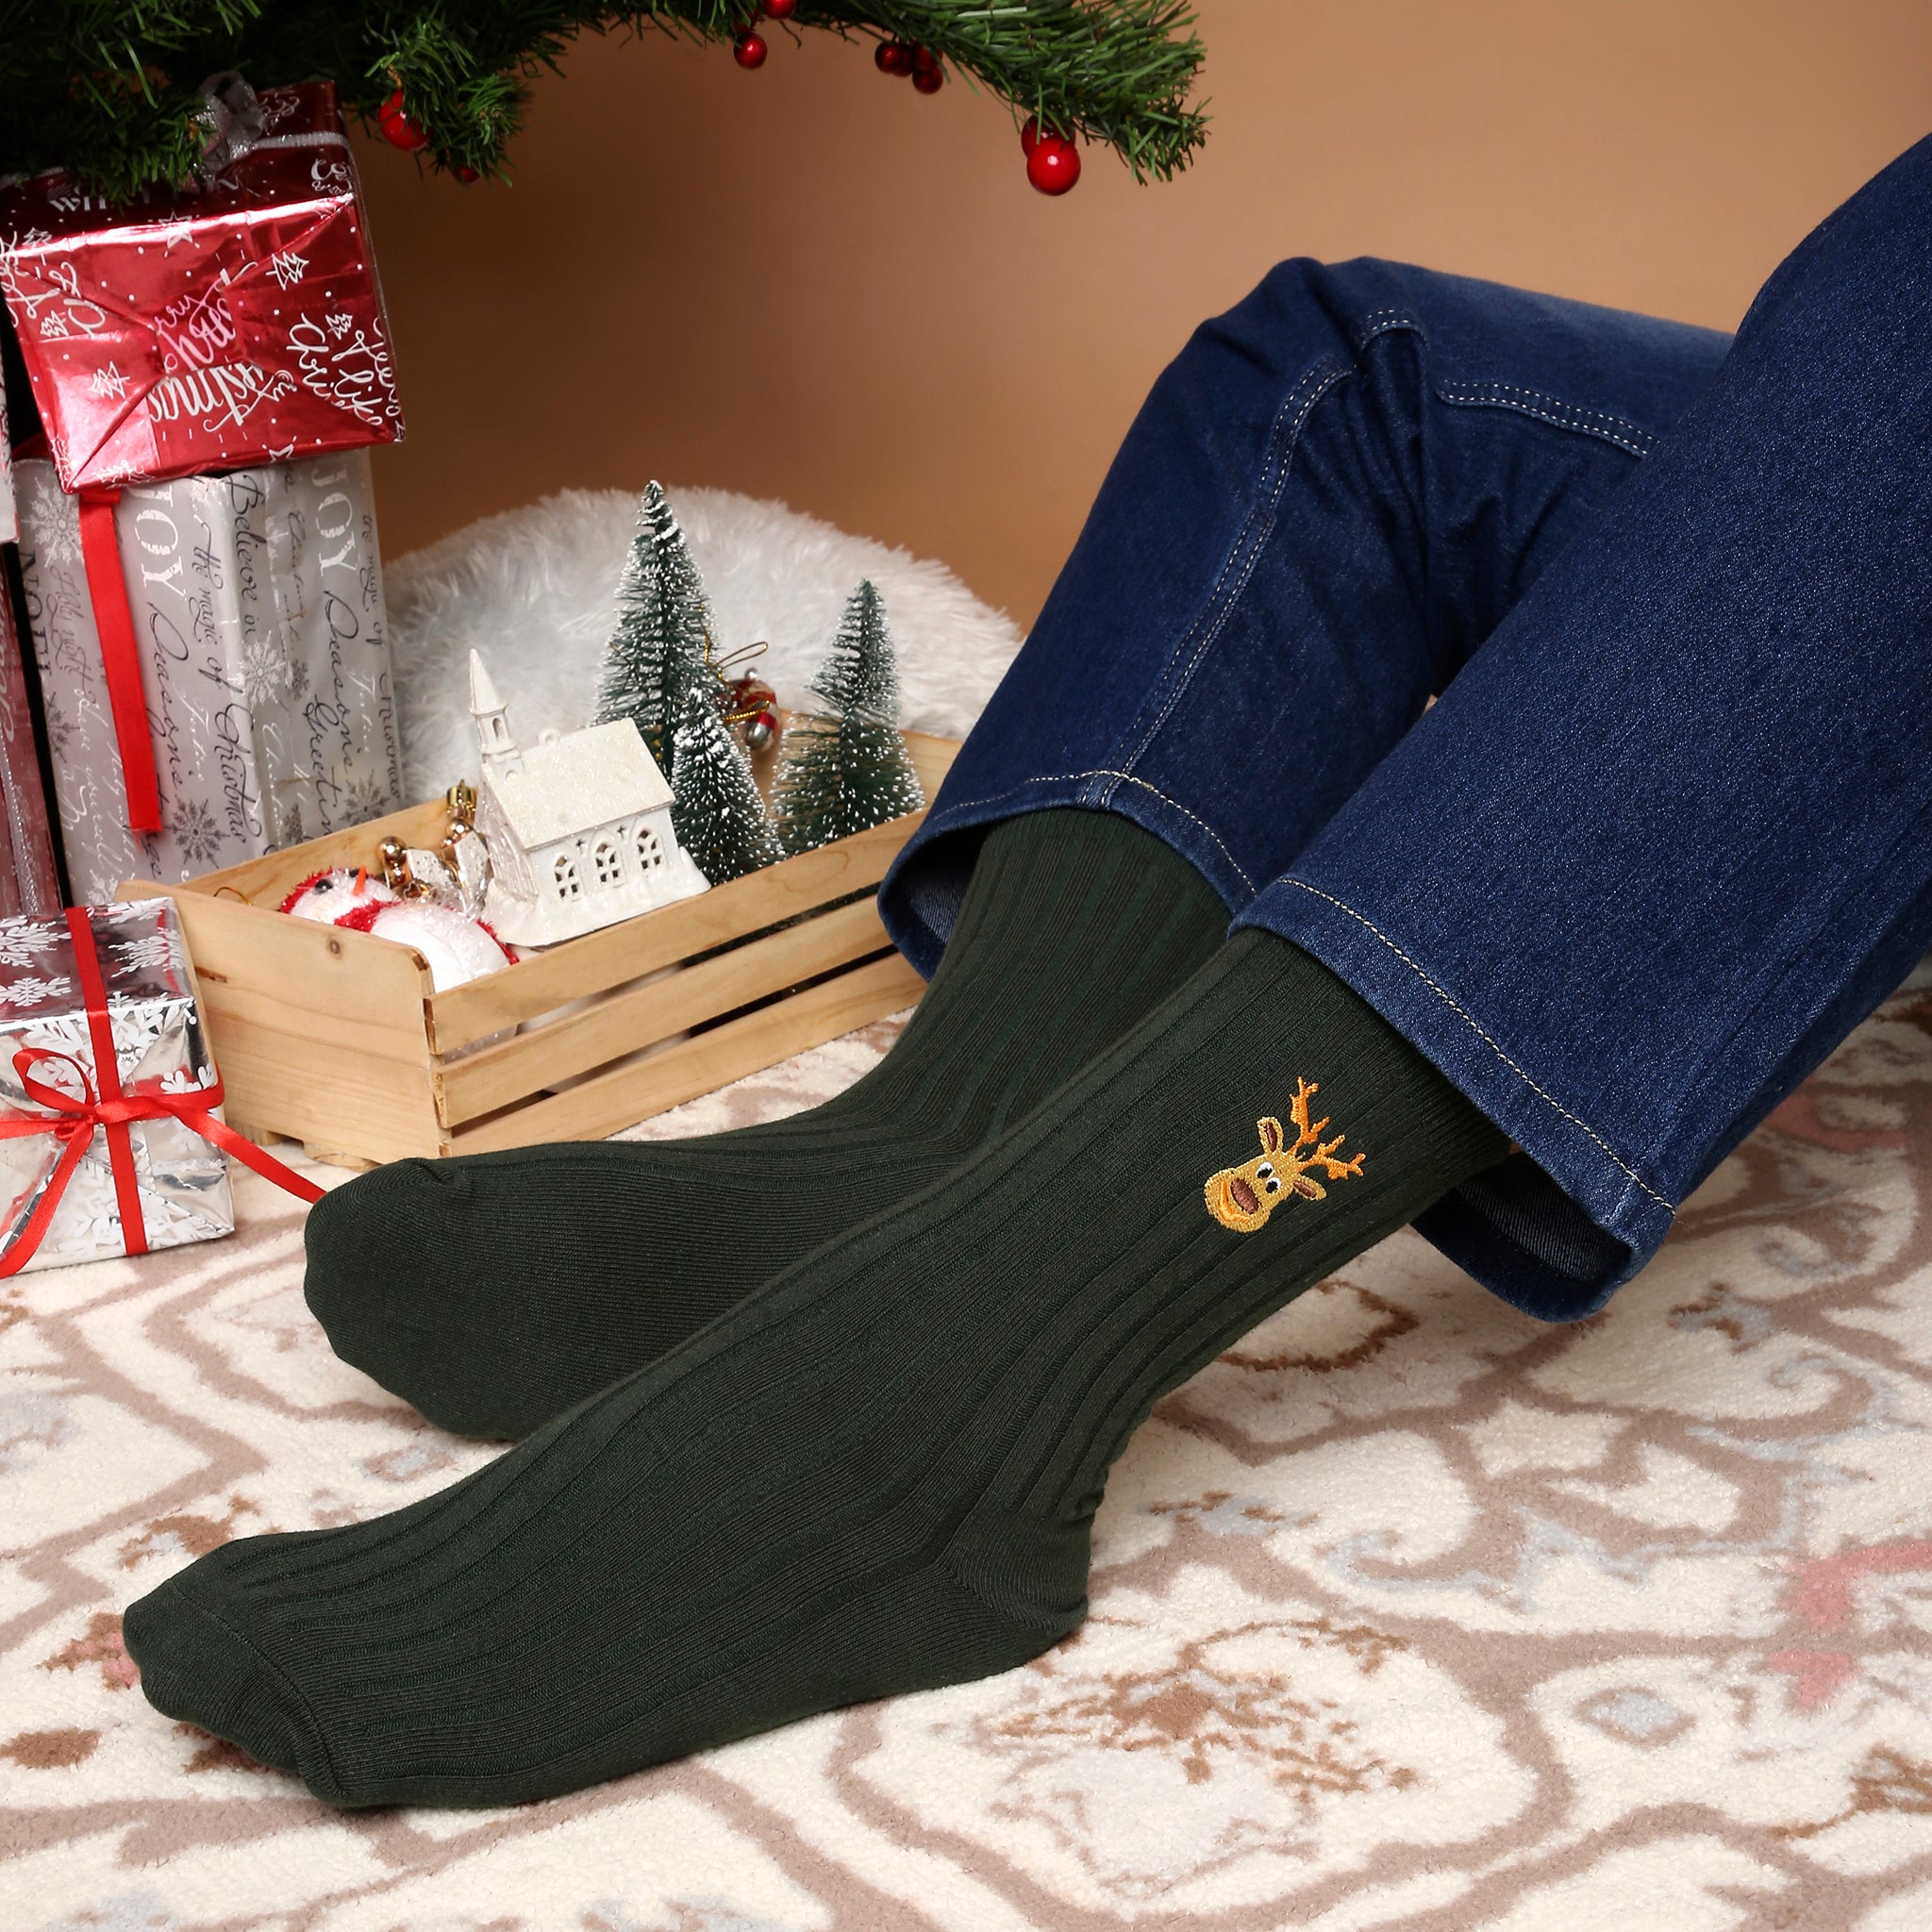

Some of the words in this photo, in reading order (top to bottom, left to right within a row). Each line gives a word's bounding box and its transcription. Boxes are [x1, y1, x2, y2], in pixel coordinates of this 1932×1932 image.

[134, 484, 188, 602] JOY
[192, 522, 225, 590] the
[225, 474, 268, 602] Believe
[310, 466, 360, 578] JOY
[189, 587, 223, 645] magic
[244, 613, 260, 635] in
[197, 656, 245, 693] of
[214, 702, 262, 843] Christmas
[302, 693, 342, 837] Greetin
